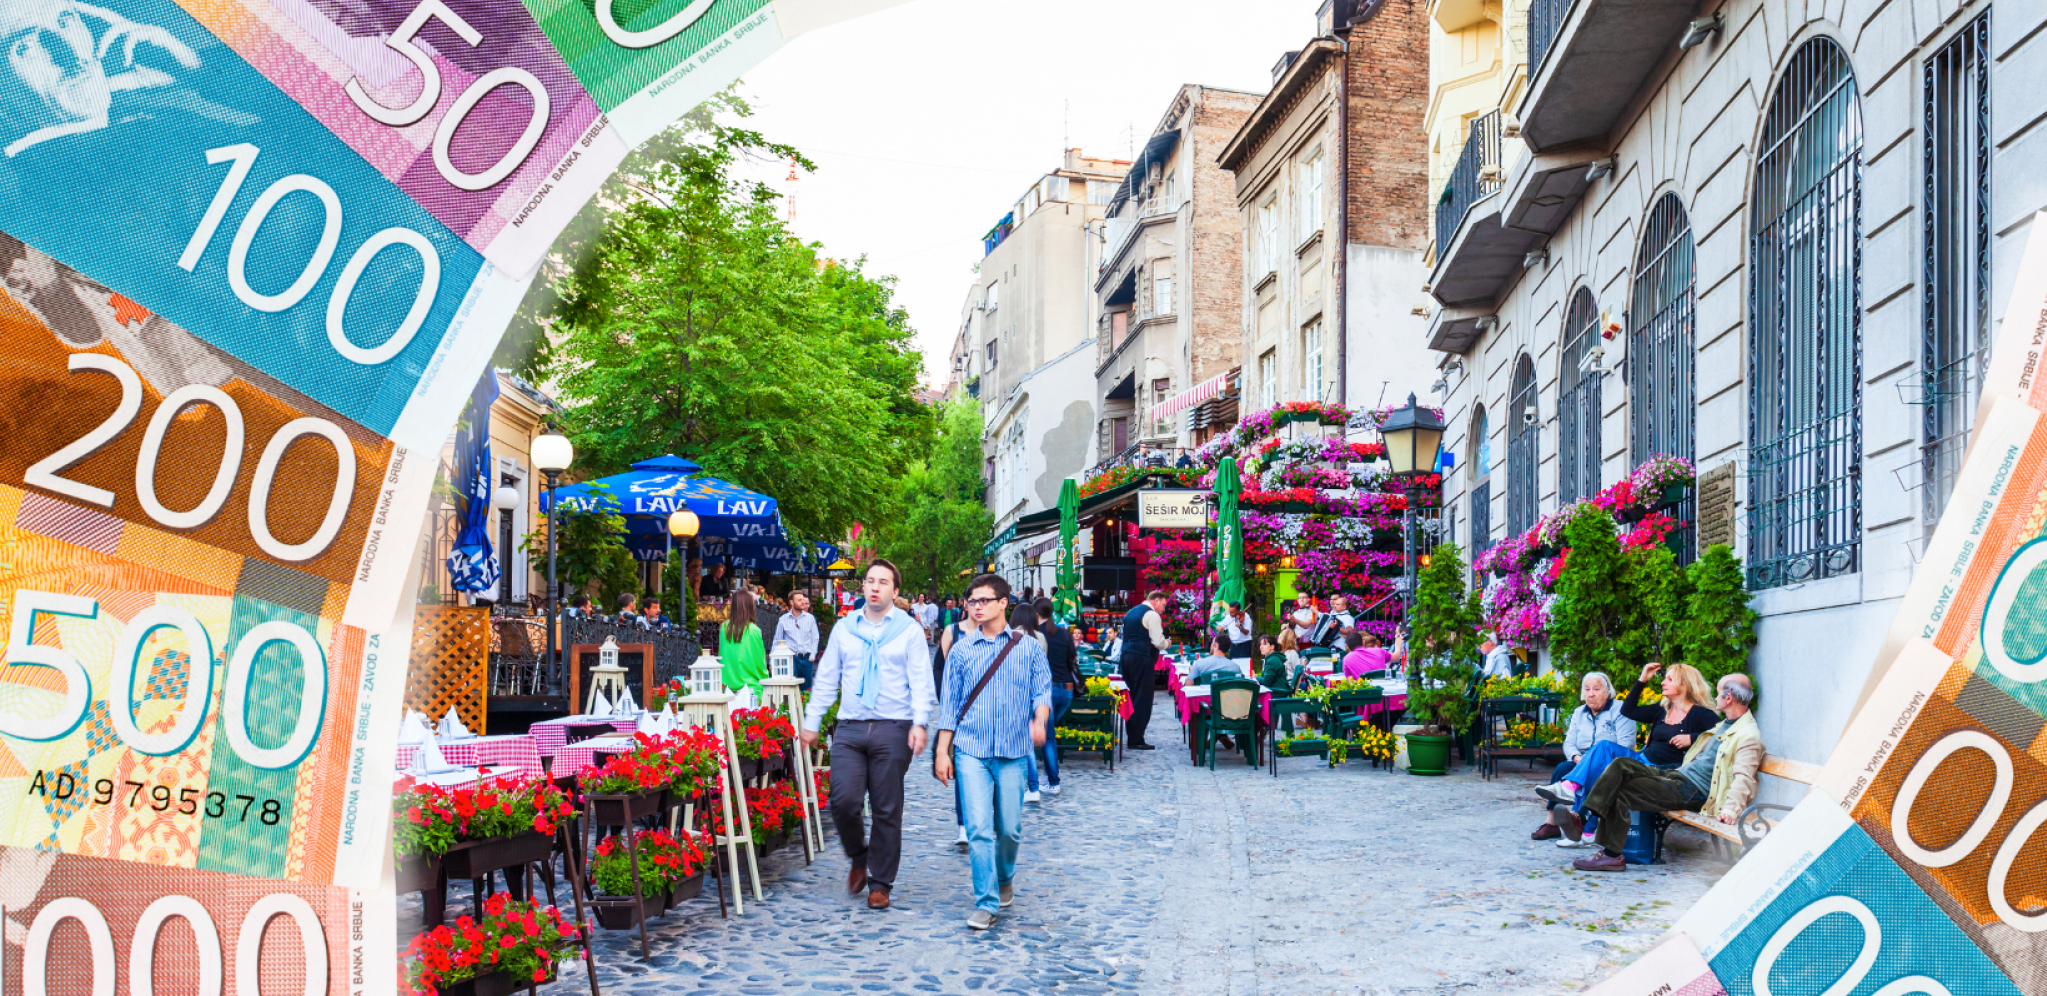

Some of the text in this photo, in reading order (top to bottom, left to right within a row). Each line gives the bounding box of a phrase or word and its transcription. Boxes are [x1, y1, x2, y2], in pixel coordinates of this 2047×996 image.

[648, 62, 697, 97] NARODNA
[698, 38, 732, 64] BANKA
[733, 13, 768, 40] SRBIJE
[344, 0, 551, 190] 50
[512, 114, 609, 228] NARODNA BANKA SRBIJE
[177, 142, 441, 364] 100
[417, 353, 447, 397] NARODNA
[443, 320, 464, 351] BANKA
[461, 285, 483, 318] SRBIJE
[2018, 350, 2039, 390] SRBIJE
[23, 352, 358, 562] 200
[1988, 444, 2019, 496] NARODNA
[358, 446, 407, 583] NARODNA BANKA SRBIJE
[635, 497, 687, 512] LAV
[717, 501, 767, 514] LAV
[1146, 504, 1204, 515] ŠEŠIR MOJ
[1969, 500, 1993, 536] BANKA
[1951, 540, 1975, 577] SRBIJE
[1930, 585, 1954, 622] ZAVOD
[369, 633, 380, 649] ZA
[1921, 626, 1936, 639] ZA
[0, 588, 328, 771] 500
[363, 653, 378, 691] ZAVOD
[357, 702, 371, 741] SRBIJE
[351, 747, 365, 785] BANKA
[1840, 690, 1926, 810] NARODNA BANKA SRBIJE
[28, 769, 281, 826] AD 9795378
[343, 789, 360, 845] NARODNA
[1774, 850, 1814, 888] NARODNA
[352, 901, 363, 941] SRBIJE
[1747, 888, 1776, 914] BANKA
[1719, 913, 1749, 941] SRBIJE
[353, 945, 364, 985] BANKA
